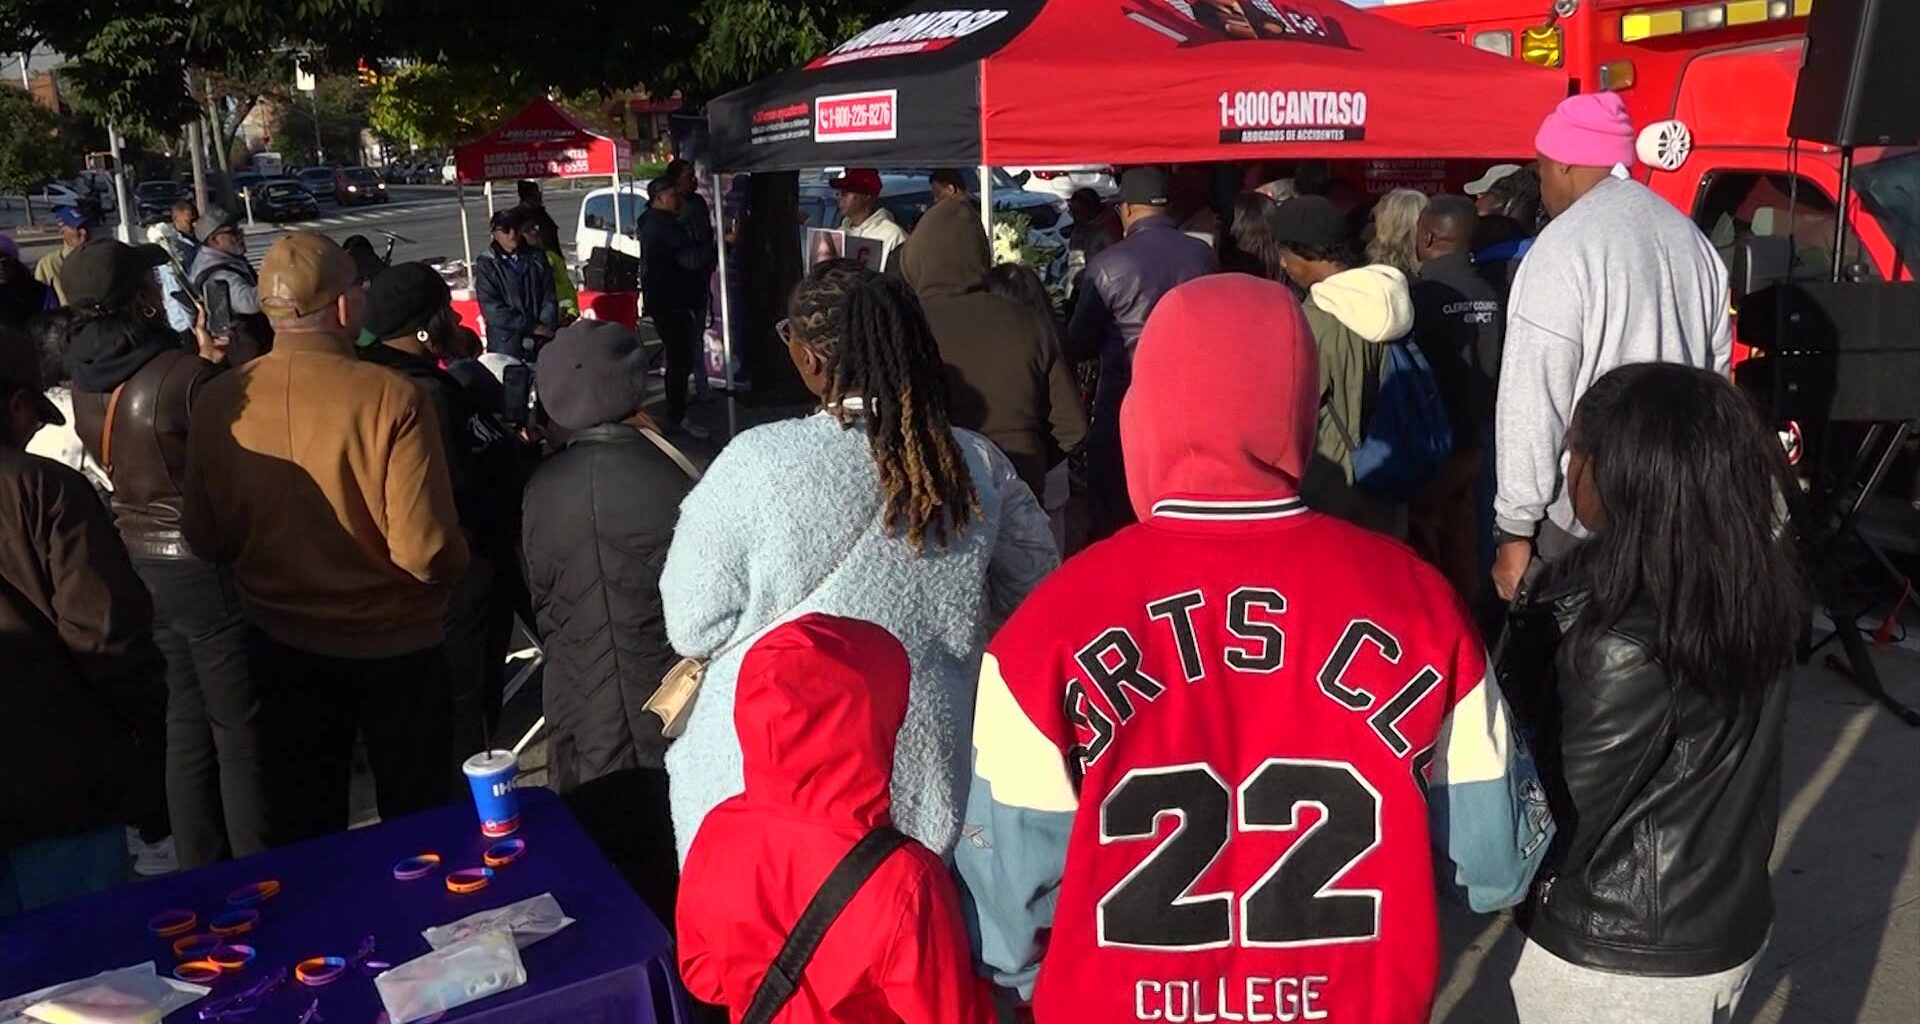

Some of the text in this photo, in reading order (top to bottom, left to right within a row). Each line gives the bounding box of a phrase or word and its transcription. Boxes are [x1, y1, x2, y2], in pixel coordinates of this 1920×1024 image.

[1218, 91, 1367, 127] 1-800CANTASO
[1241, 129, 1344, 142] ABOGADOS DE ACCIDENTES
[1097, 758, 1383, 949] 22
[1135, 975, 1329, 1022] COLLEGE
